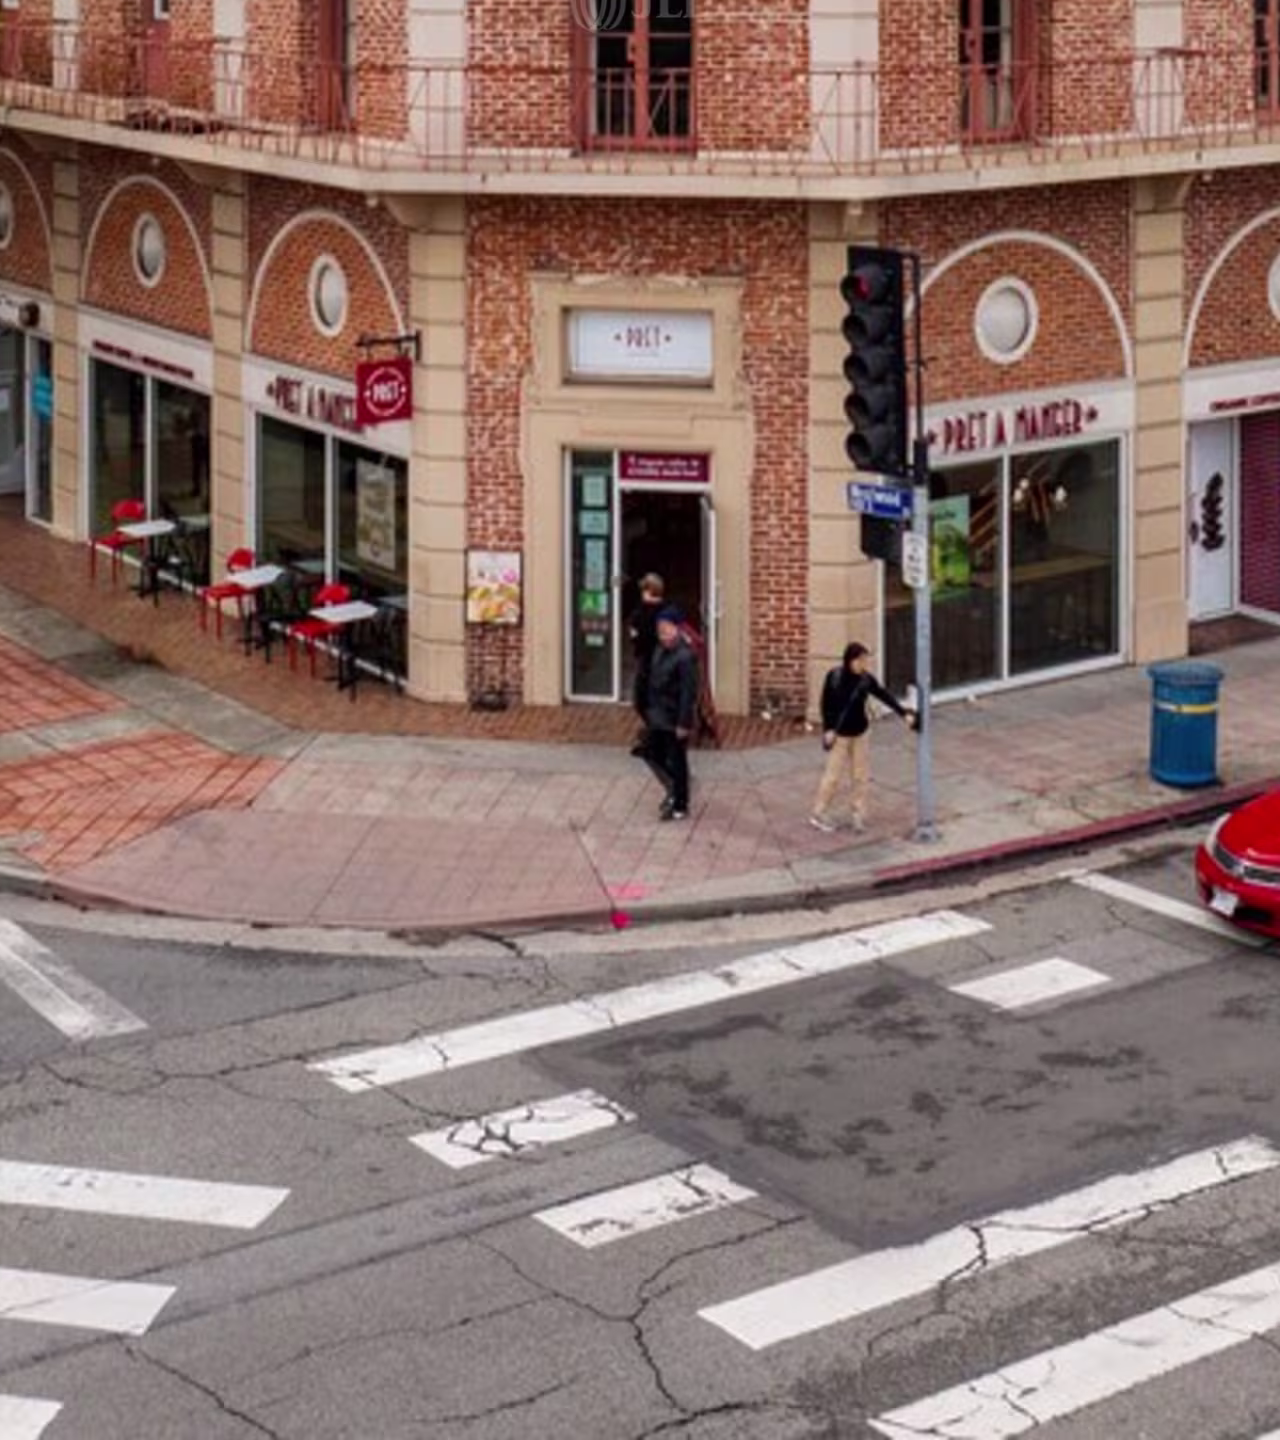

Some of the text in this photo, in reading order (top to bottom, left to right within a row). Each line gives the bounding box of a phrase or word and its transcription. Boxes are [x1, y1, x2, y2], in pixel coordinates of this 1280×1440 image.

[944, 399, 1083, 454] PRET A MANGER
